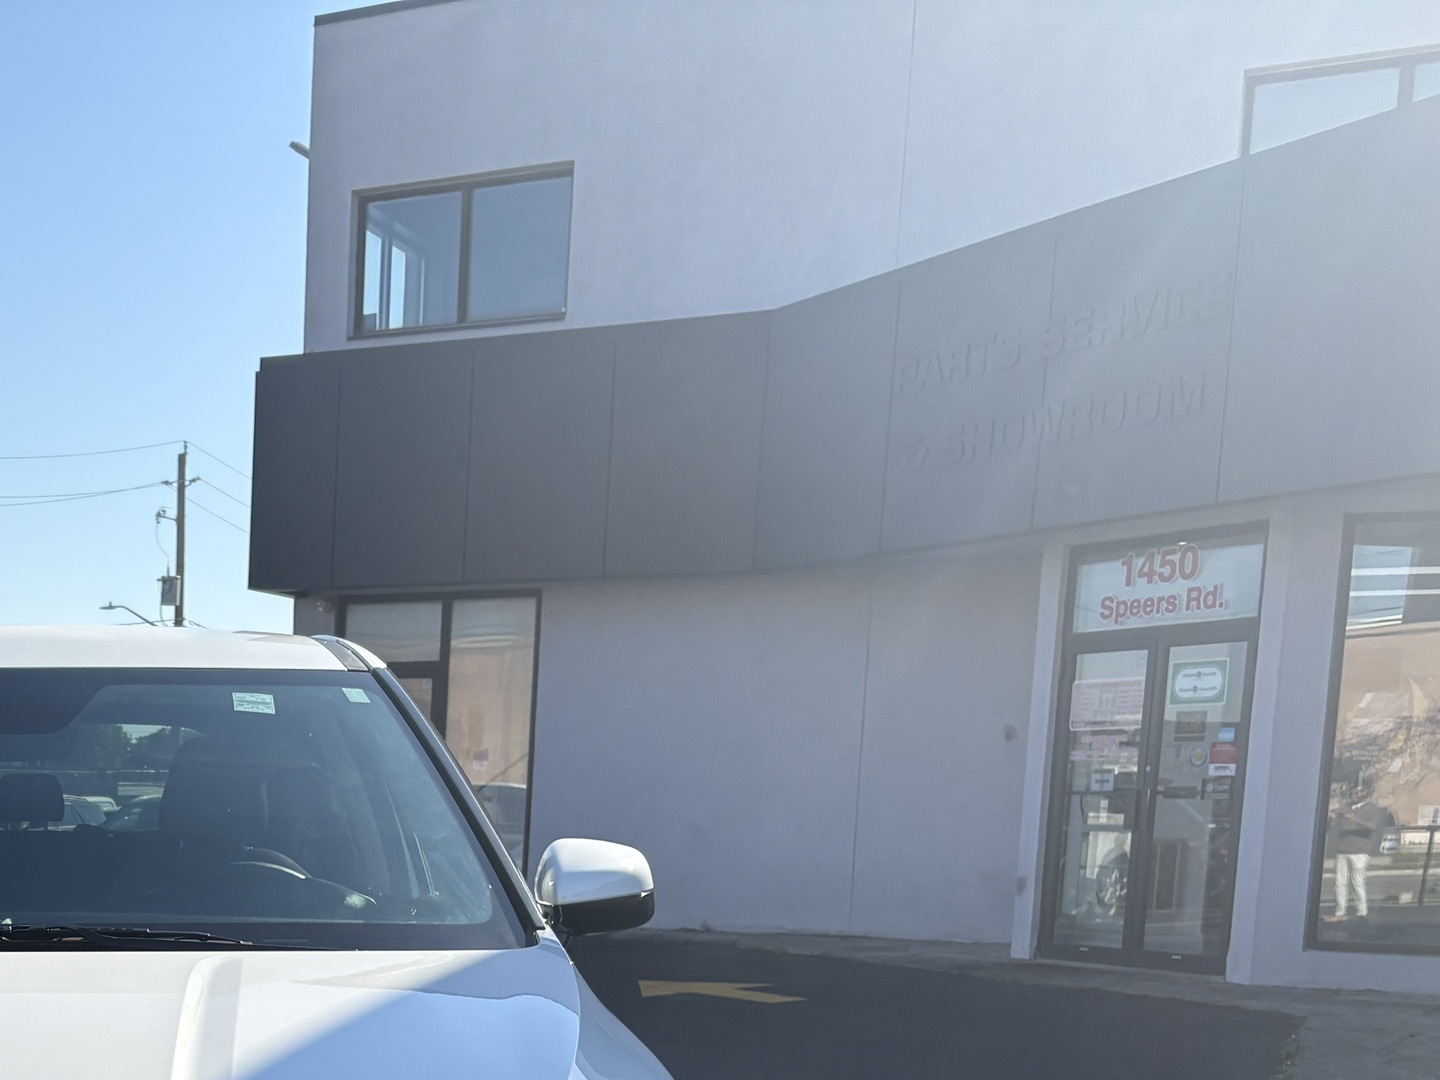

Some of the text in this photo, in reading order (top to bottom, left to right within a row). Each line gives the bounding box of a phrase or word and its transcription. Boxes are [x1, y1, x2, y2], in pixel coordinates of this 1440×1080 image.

[897, 270, 1234, 397] PARTS SERVICE
[941, 370, 1207, 466] SHOWROOM
[1121, 543, 1200, 587] 1450
[1099, 584, 1224, 625] Speers Rd.
